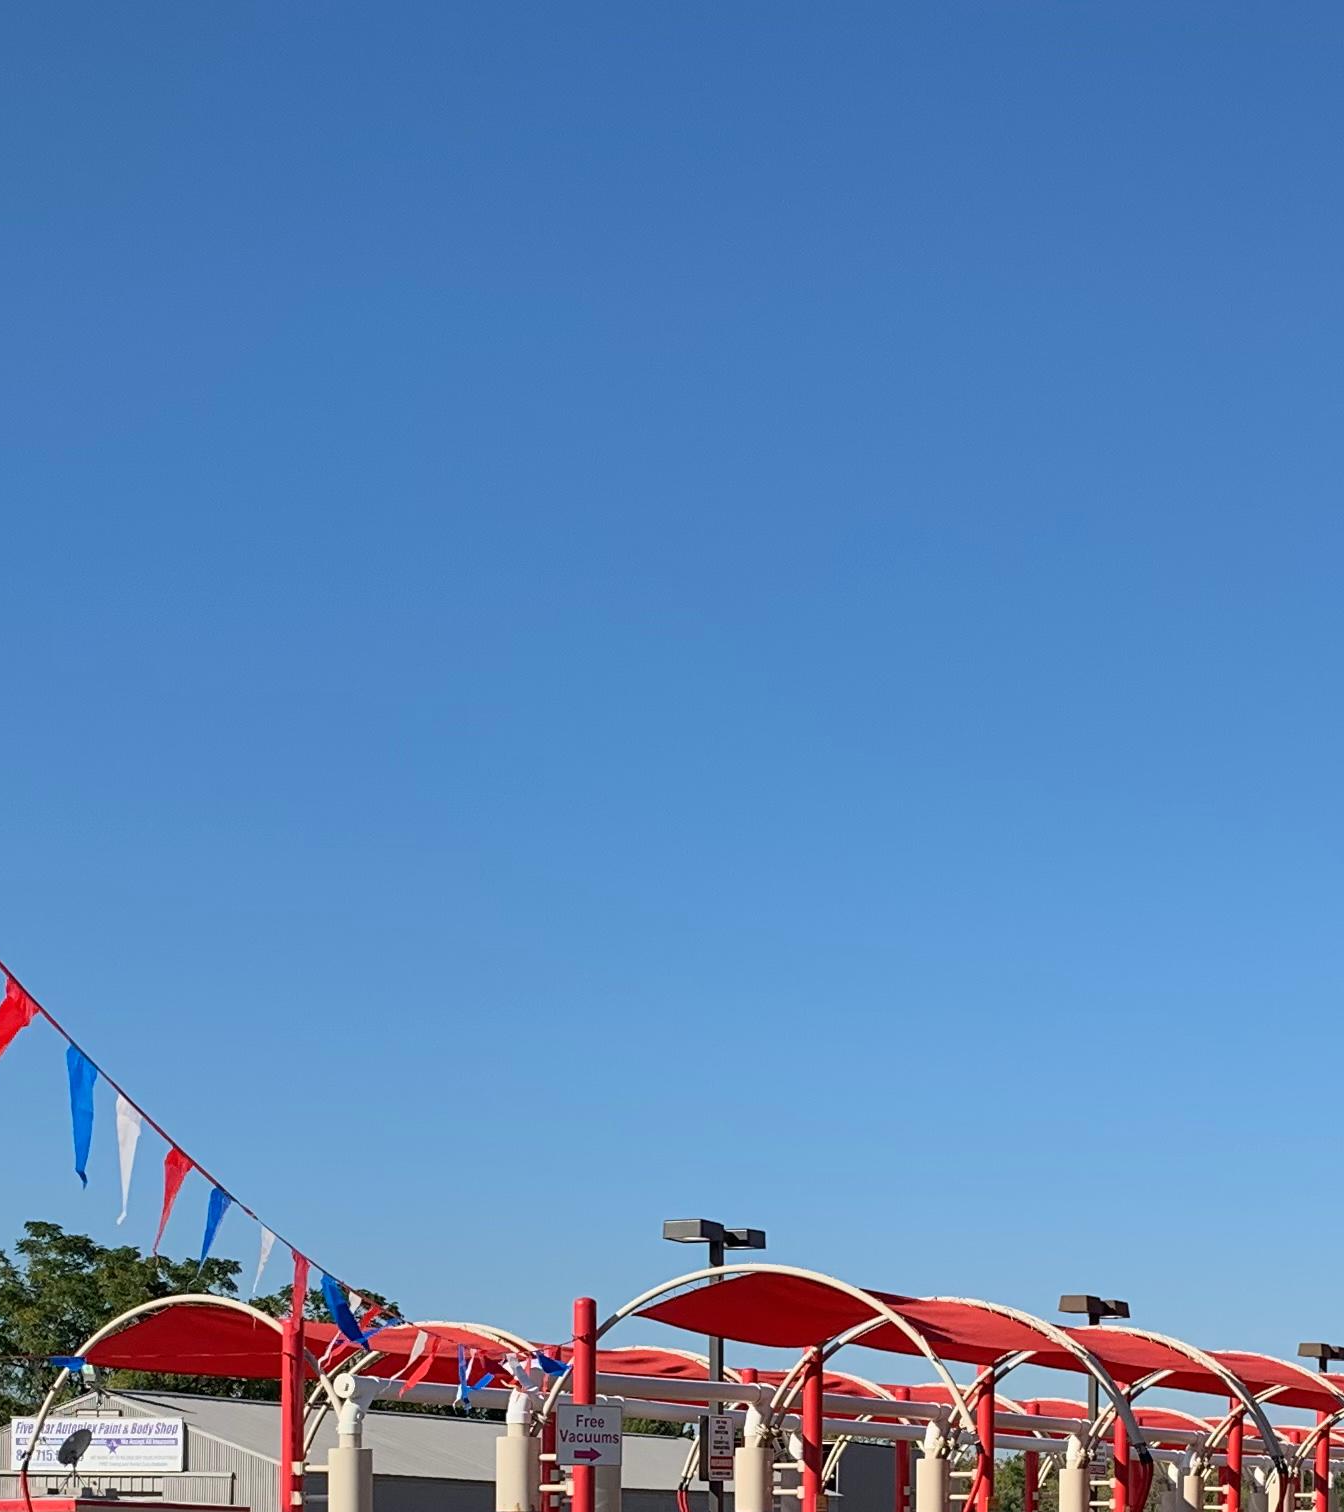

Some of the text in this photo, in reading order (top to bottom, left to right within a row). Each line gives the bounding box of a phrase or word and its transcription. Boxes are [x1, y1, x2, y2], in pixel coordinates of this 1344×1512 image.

[16, 1421, 34, 1434] Five
[98, 1422, 121, 1435] Paint
[122, 1425, 129, 1435] &
[130, 1422, 154, 1436] Body
[154, 1422, 178, 1436] Shop
[576, 1414, 605, 1428] Free
[559, 1429, 620, 1444] Vacuums
